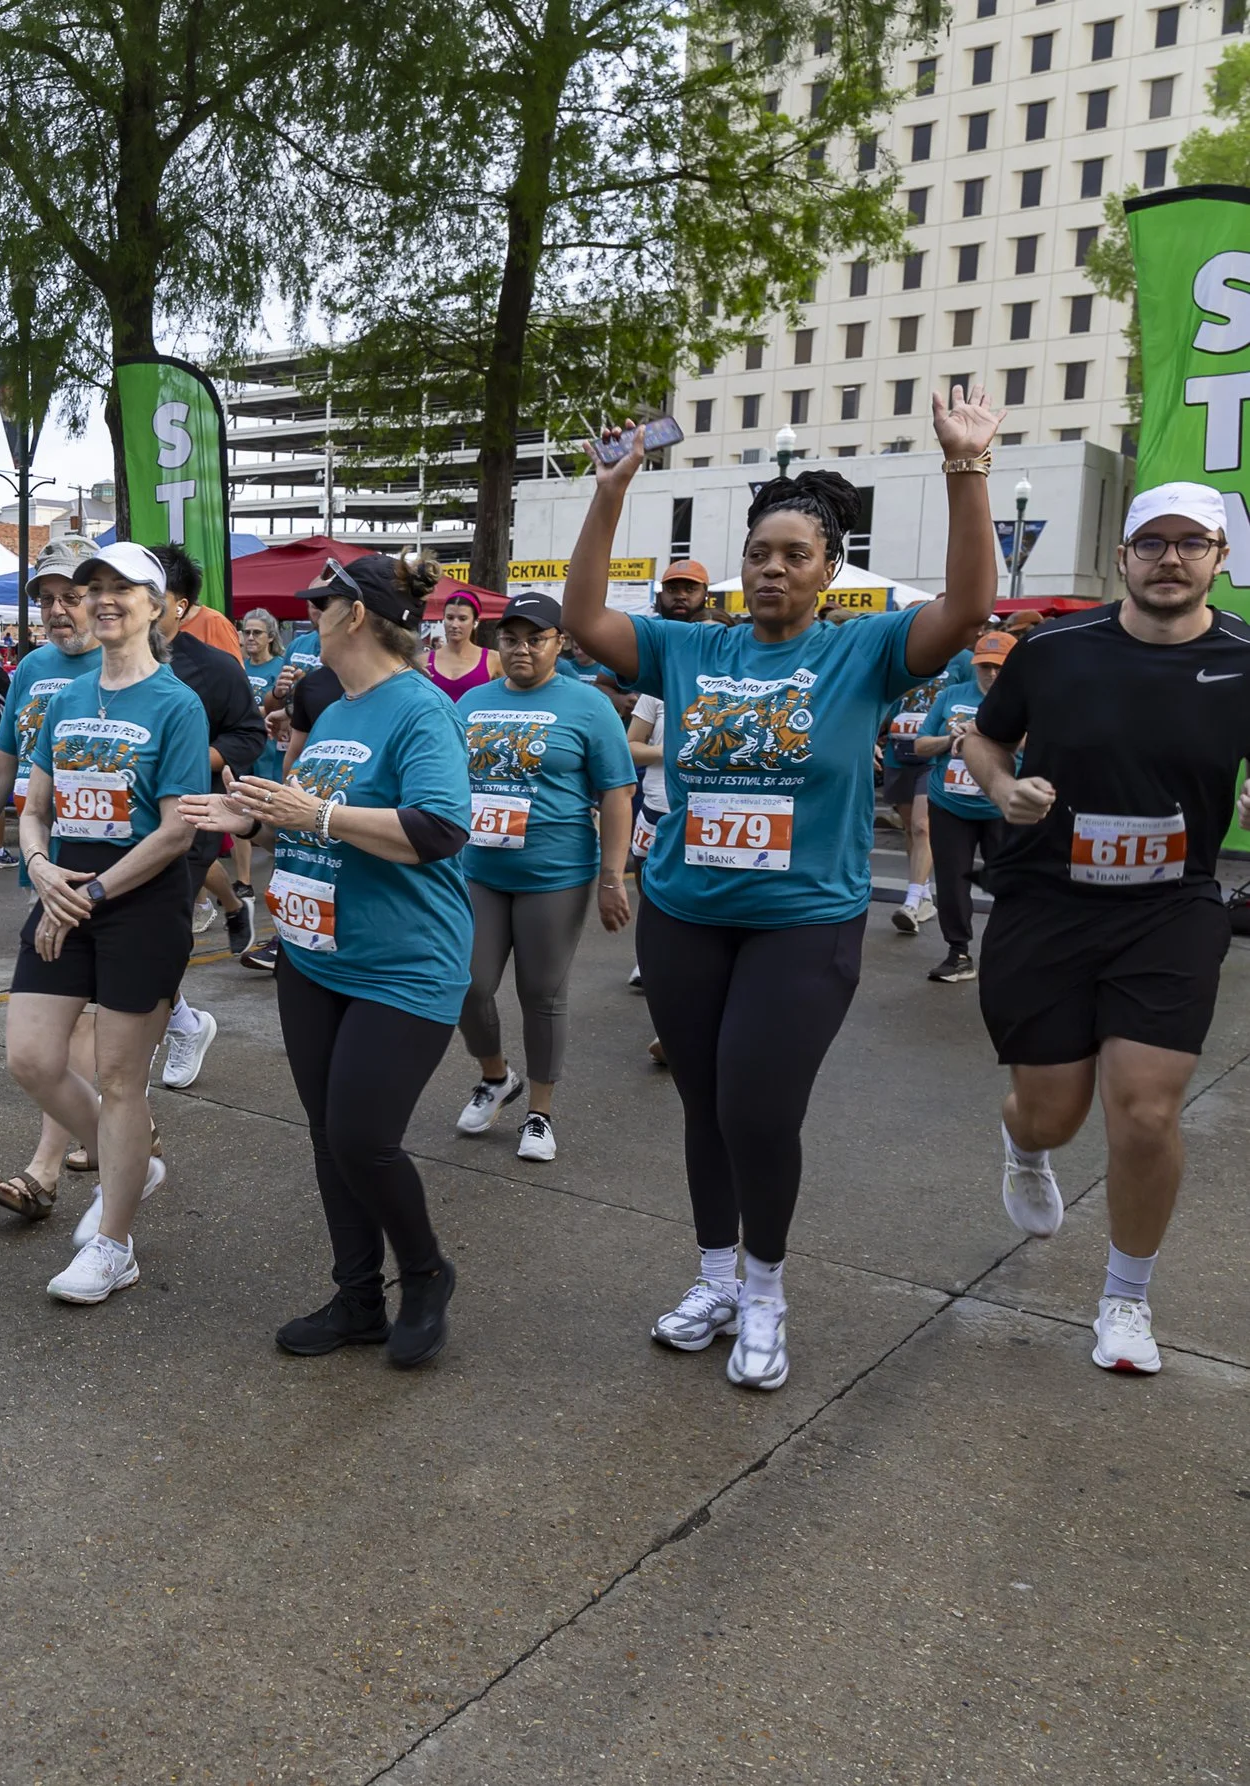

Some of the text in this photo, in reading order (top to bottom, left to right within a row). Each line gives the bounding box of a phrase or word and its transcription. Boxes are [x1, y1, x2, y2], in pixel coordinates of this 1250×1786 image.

[826, 593, 873, 608] BEER
[704, 776, 718, 784] DU
[718, 776, 761, 786] FESTIVAL
[763, 776, 777, 786] 5K
[777, 776, 806, 786] 2026
[61, 788, 115, 819] 398
[730, 797, 761, 805] Festival
[762, 798, 782, 806] 2026
[471, 808, 511, 834] 751
[700, 813, 771, 848] 579
[1091, 836, 1168, 867] 615
[275, 894, 321, 931] 399
